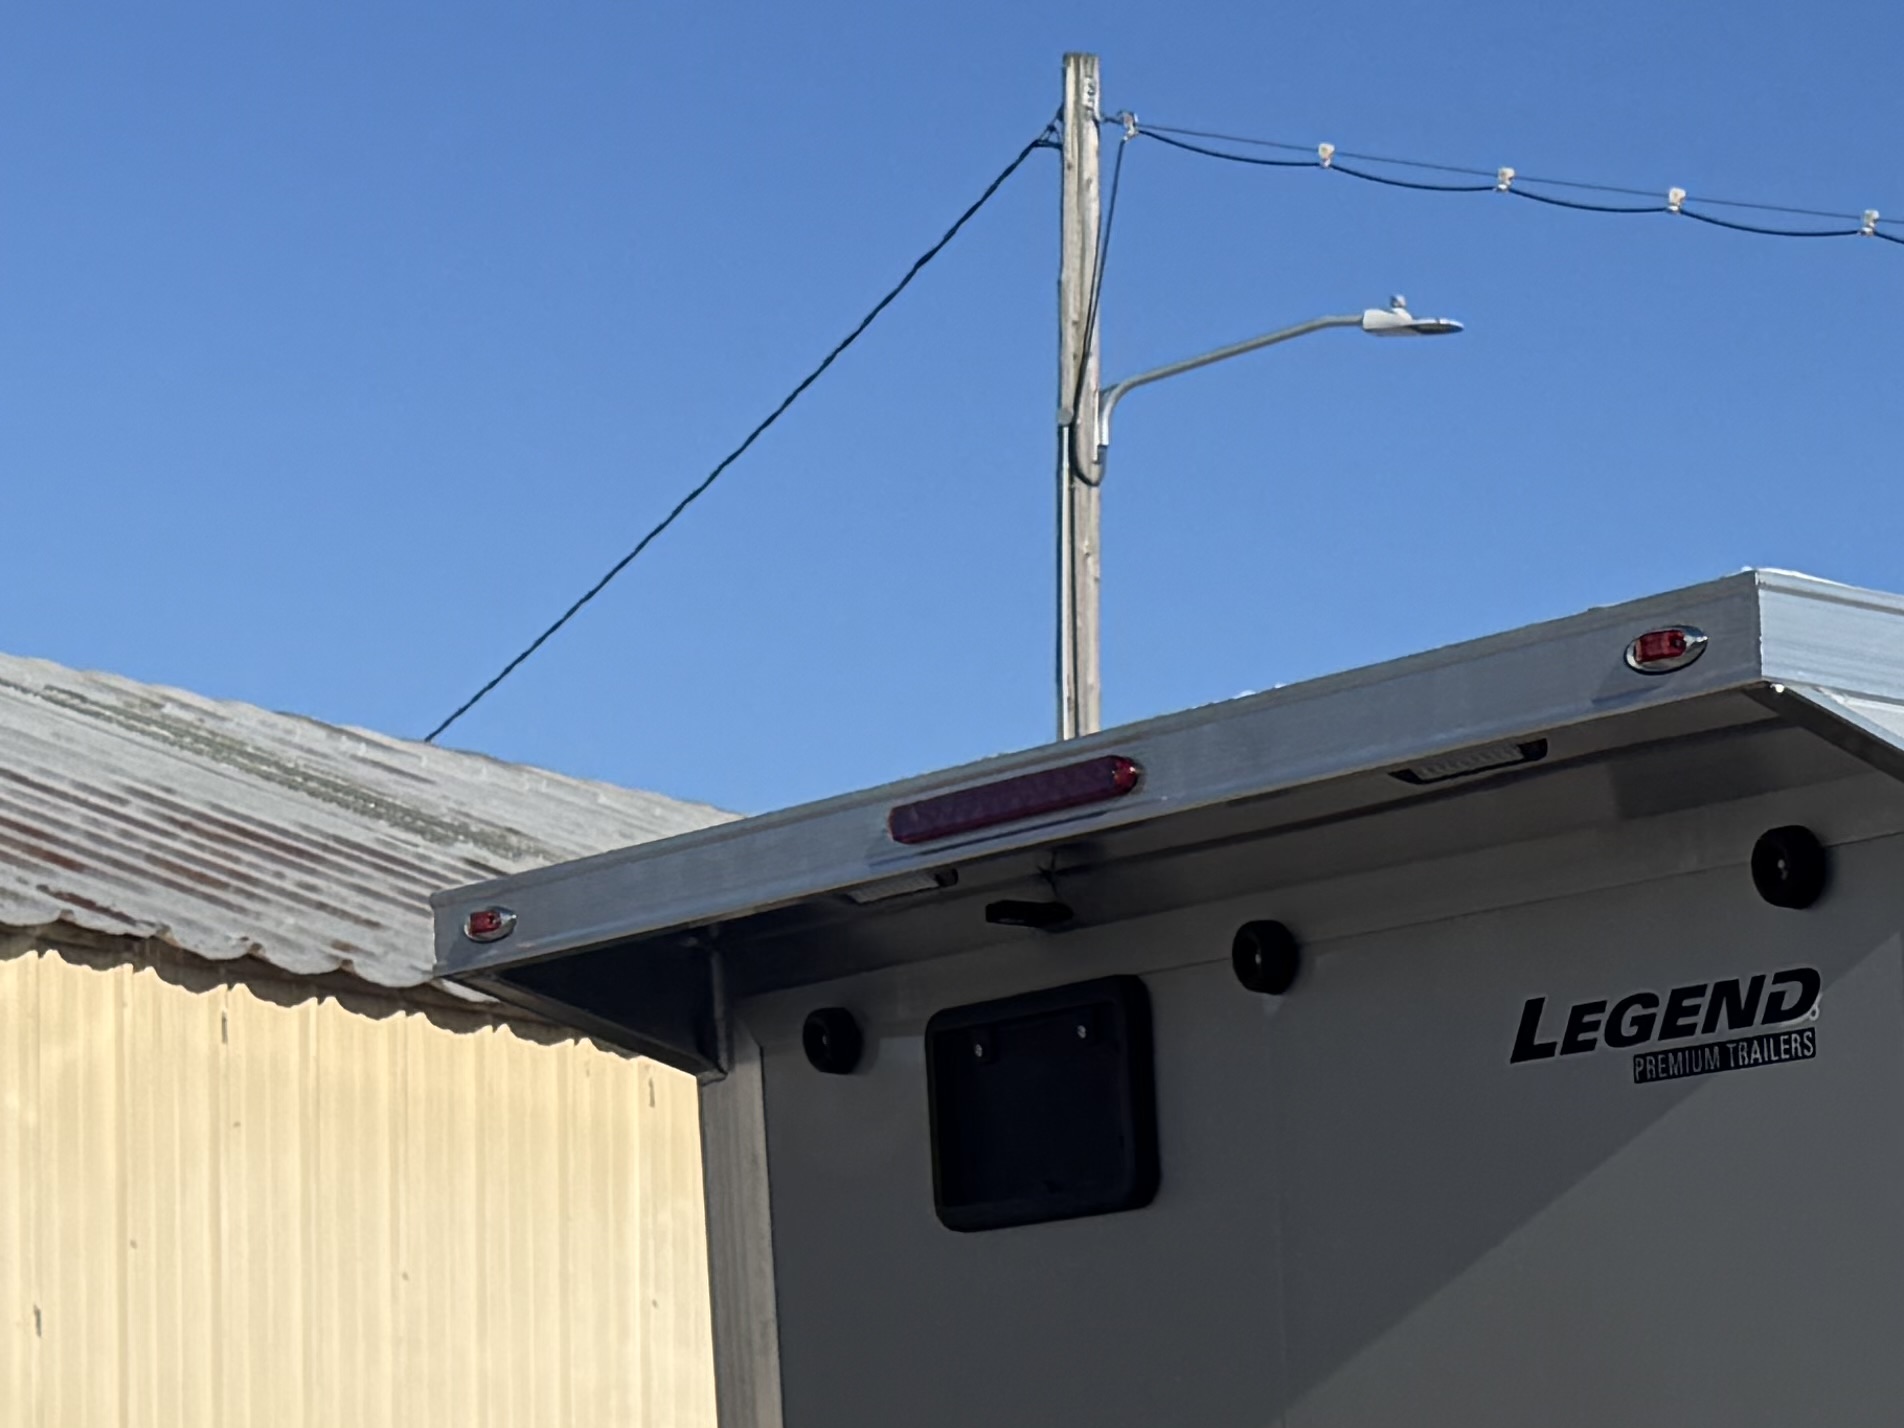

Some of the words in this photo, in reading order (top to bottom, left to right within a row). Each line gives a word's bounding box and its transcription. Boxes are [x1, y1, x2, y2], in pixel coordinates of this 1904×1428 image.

[1509, 967, 1822, 1065] LEGEND
[1634, 1045, 1721, 1082] PREMIUM
[1727, 1030, 1815, 1070] TRAILERS
